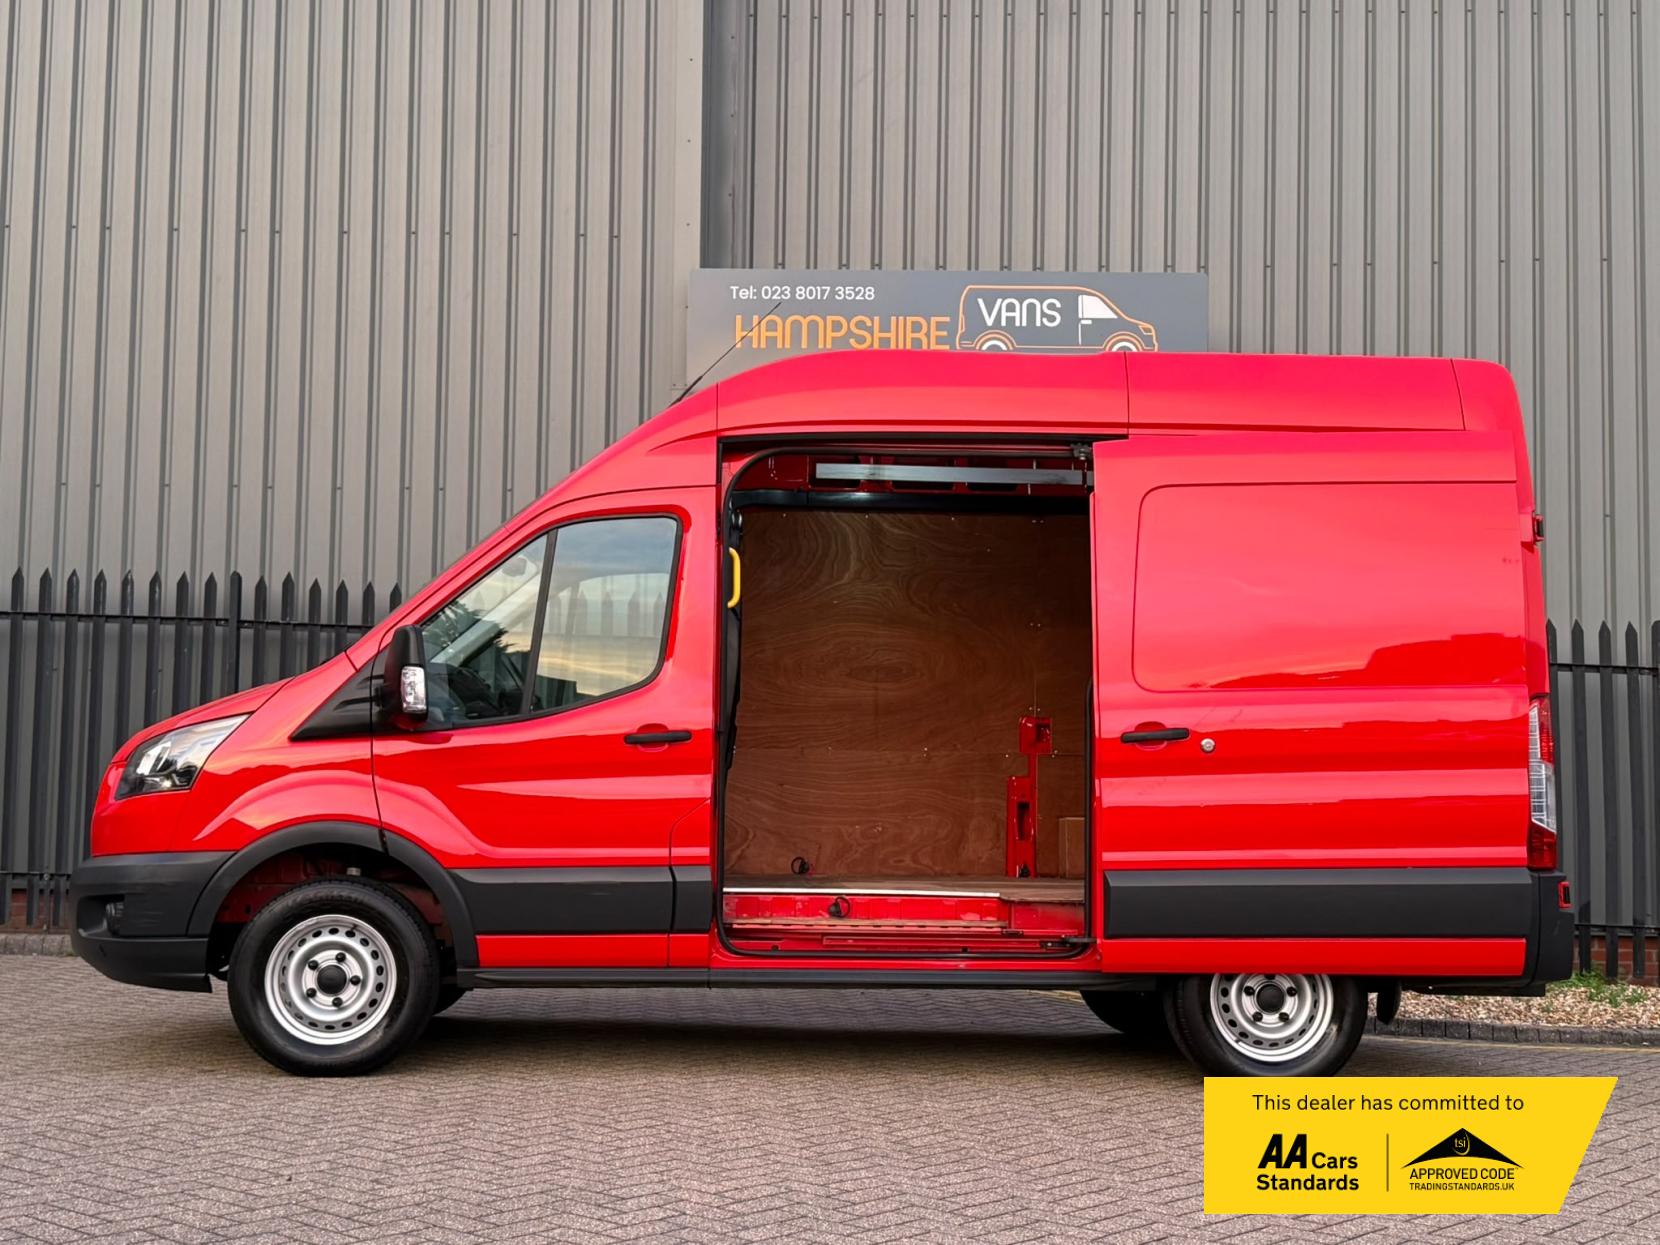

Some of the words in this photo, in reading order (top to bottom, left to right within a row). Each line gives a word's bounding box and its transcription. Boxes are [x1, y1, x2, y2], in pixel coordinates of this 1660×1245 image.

[729, 284, 757, 300] Tel:
[761, 285, 791, 300] 023
[795, 285, 831, 300] 8017
[834, 286, 876, 301] 3528
[977, 297, 1062, 328] VANS
[734, 314, 951, 350] HAMPSHIRE
